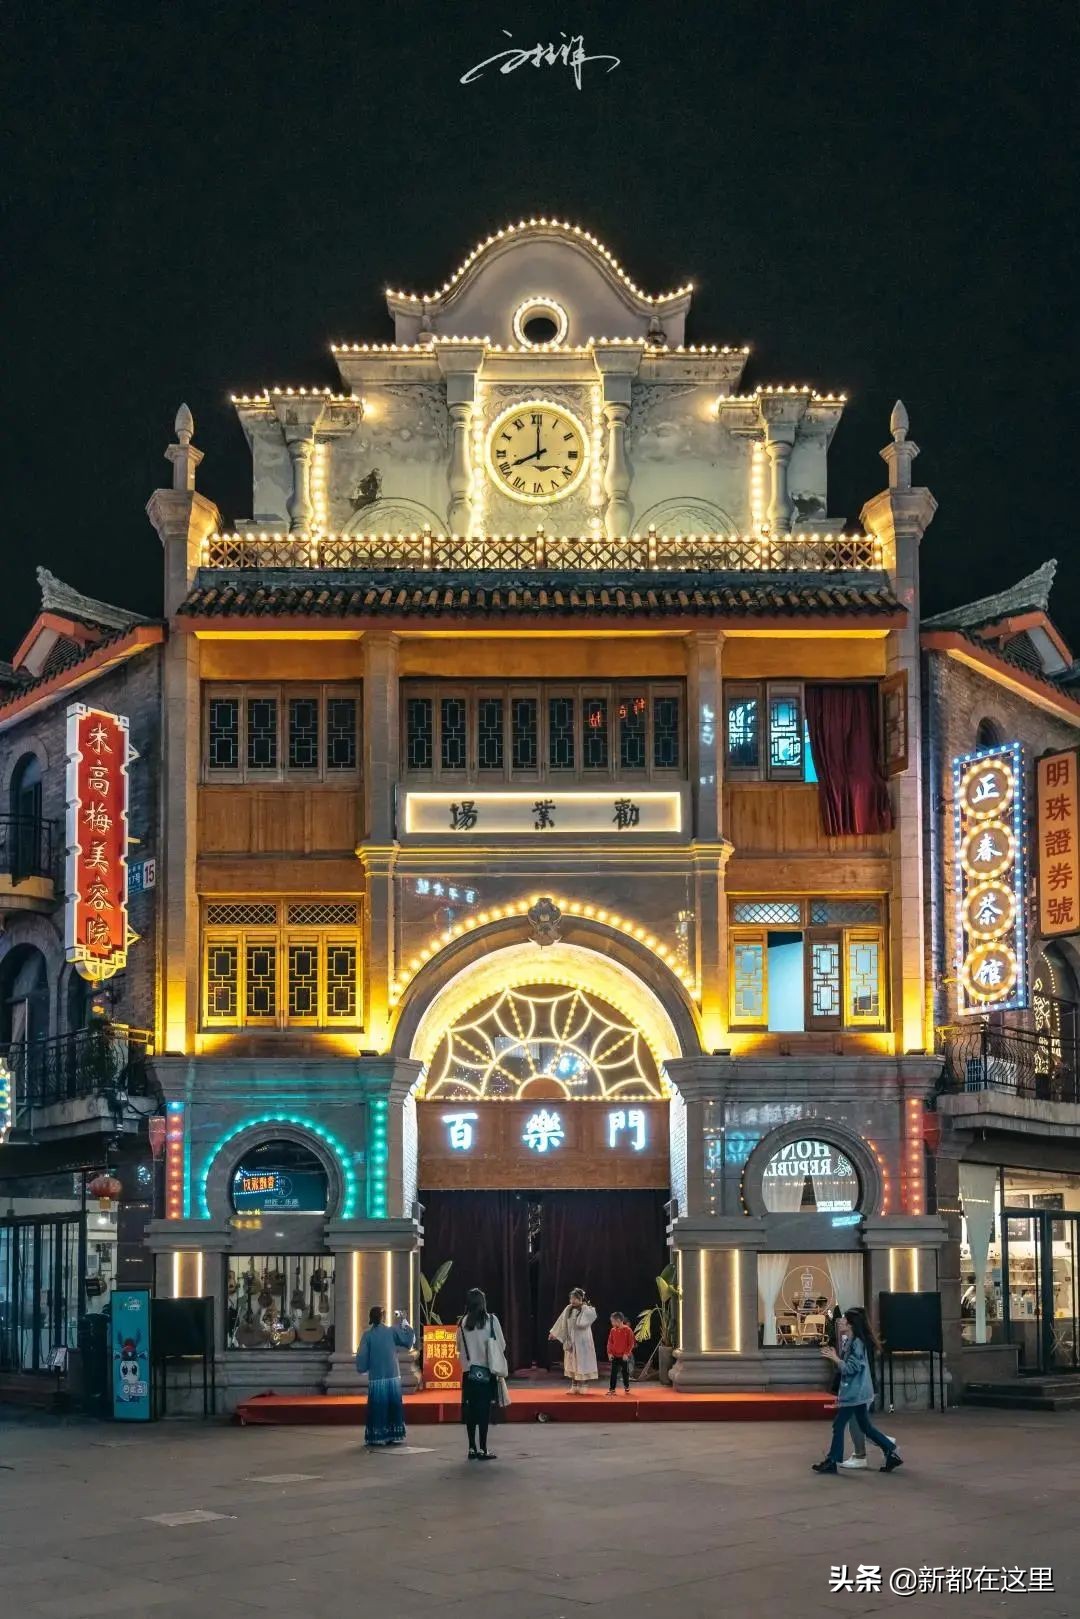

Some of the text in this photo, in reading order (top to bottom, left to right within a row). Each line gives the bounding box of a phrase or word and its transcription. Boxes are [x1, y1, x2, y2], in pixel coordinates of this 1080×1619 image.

[84, 722, 113, 950] 米高梅美容院
[145, 863, 155, 885] 15
[441, 1109, 646, 1152] 百樂門
